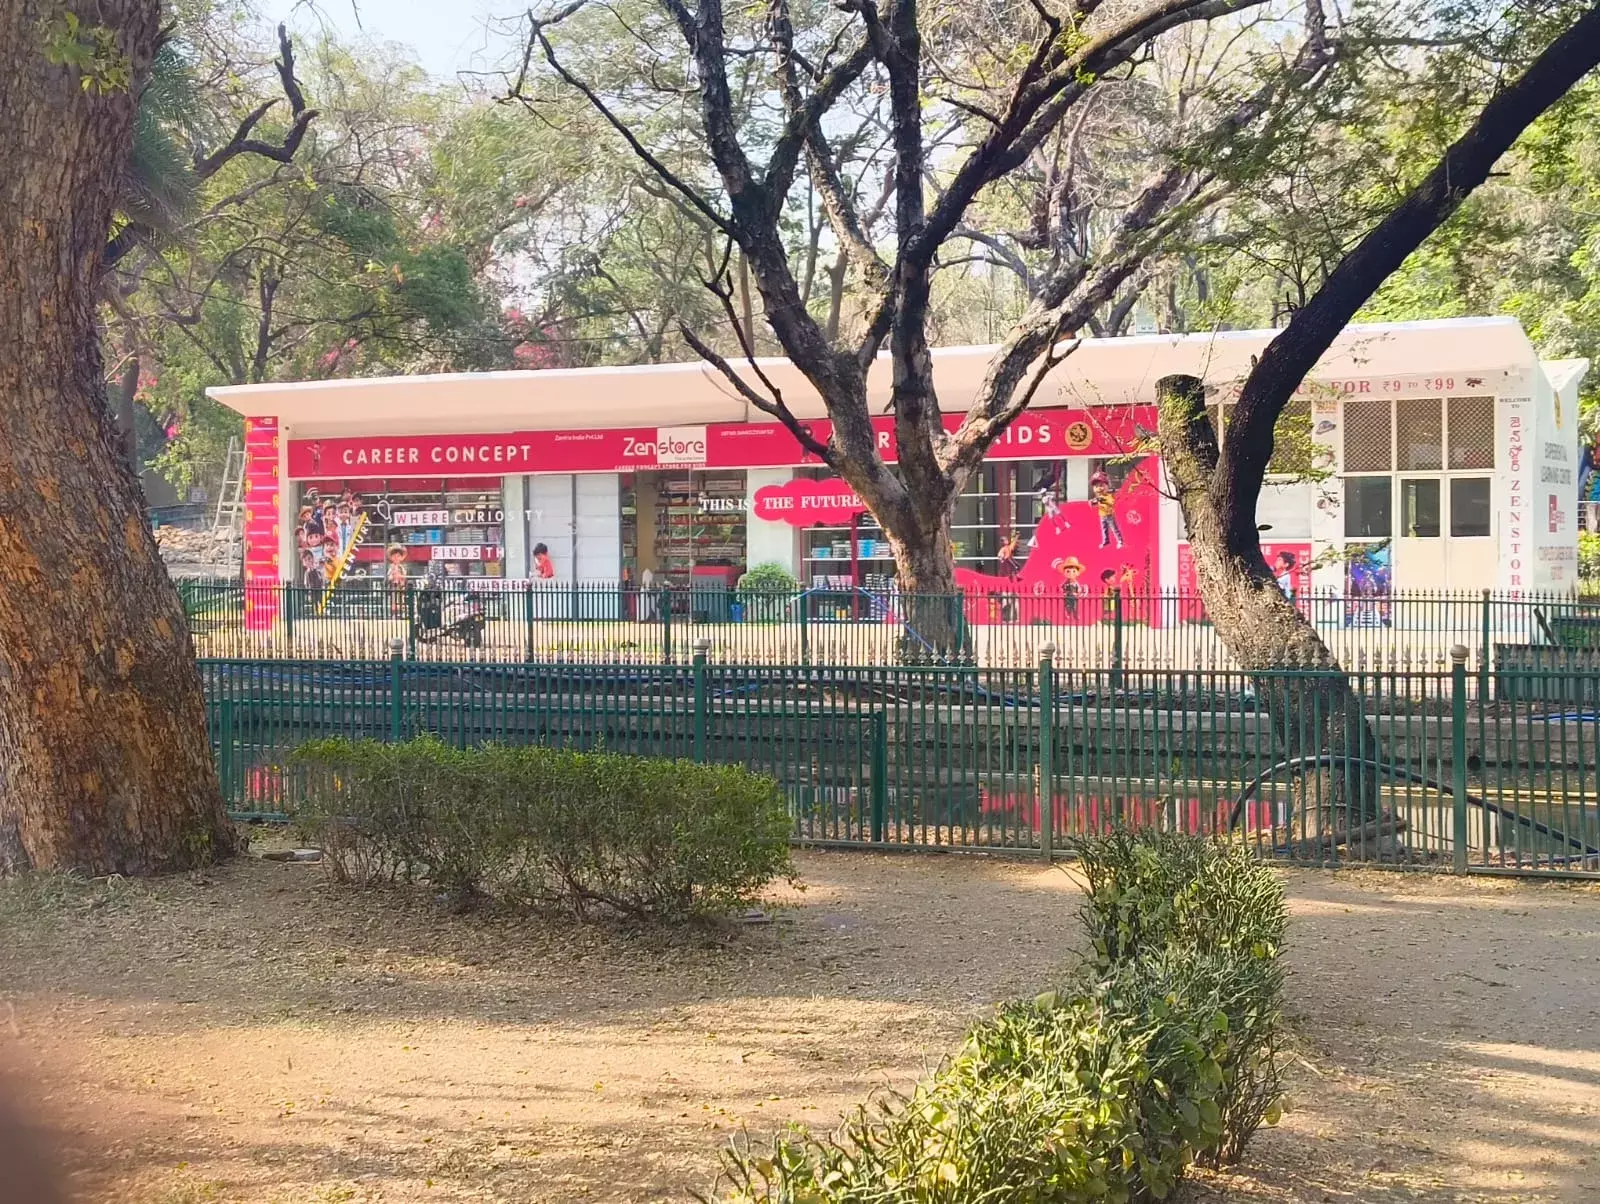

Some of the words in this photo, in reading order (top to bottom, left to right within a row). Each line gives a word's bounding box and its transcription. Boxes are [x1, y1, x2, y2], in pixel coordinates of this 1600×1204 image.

[1424, 377, 1455, 391] ₹99
[995, 424, 1051, 445] IDS
[343, 447, 419, 464] CAREER
[431, 445, 531, 463] CONCEPT
[623, 436, 704, 456] Zenstore
[700, 499, 734, 511] THIS
[738, 499, 750, 511] IS
[763, 497, 794, 510] THE
[802, 494, 864, 509] FUTURE
[396, 513, 448, 524] WHERE
[339, 518, 372, 580] CENTURY
[433, 547, 480, 559] FINDS
